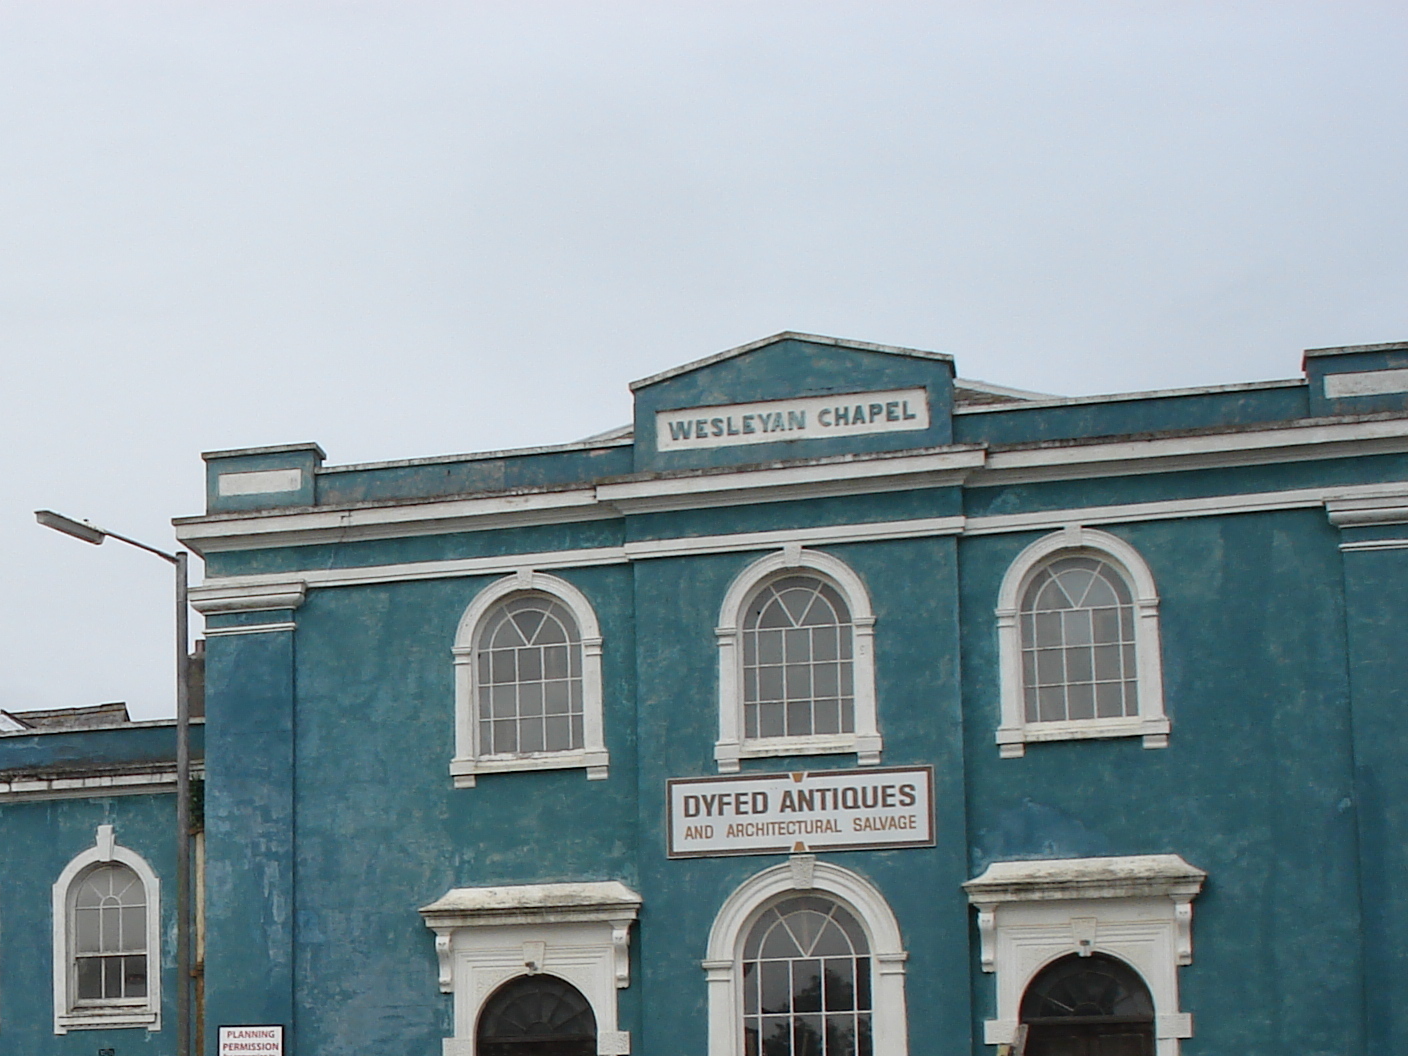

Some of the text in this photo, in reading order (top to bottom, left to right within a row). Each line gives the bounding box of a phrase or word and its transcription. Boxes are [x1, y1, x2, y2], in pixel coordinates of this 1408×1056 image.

[669, 400, 917, 441] WESLEYAN CHAPEL
[683, 784, 916, 818] DYFED ANTIQUES
[684, 815, 917, 840] AND ARCHITECTURAL SALVAGE
[223, 1043, 279, 1051] PERMISSION
[227, 1030, 275, 1039] PLANNING
